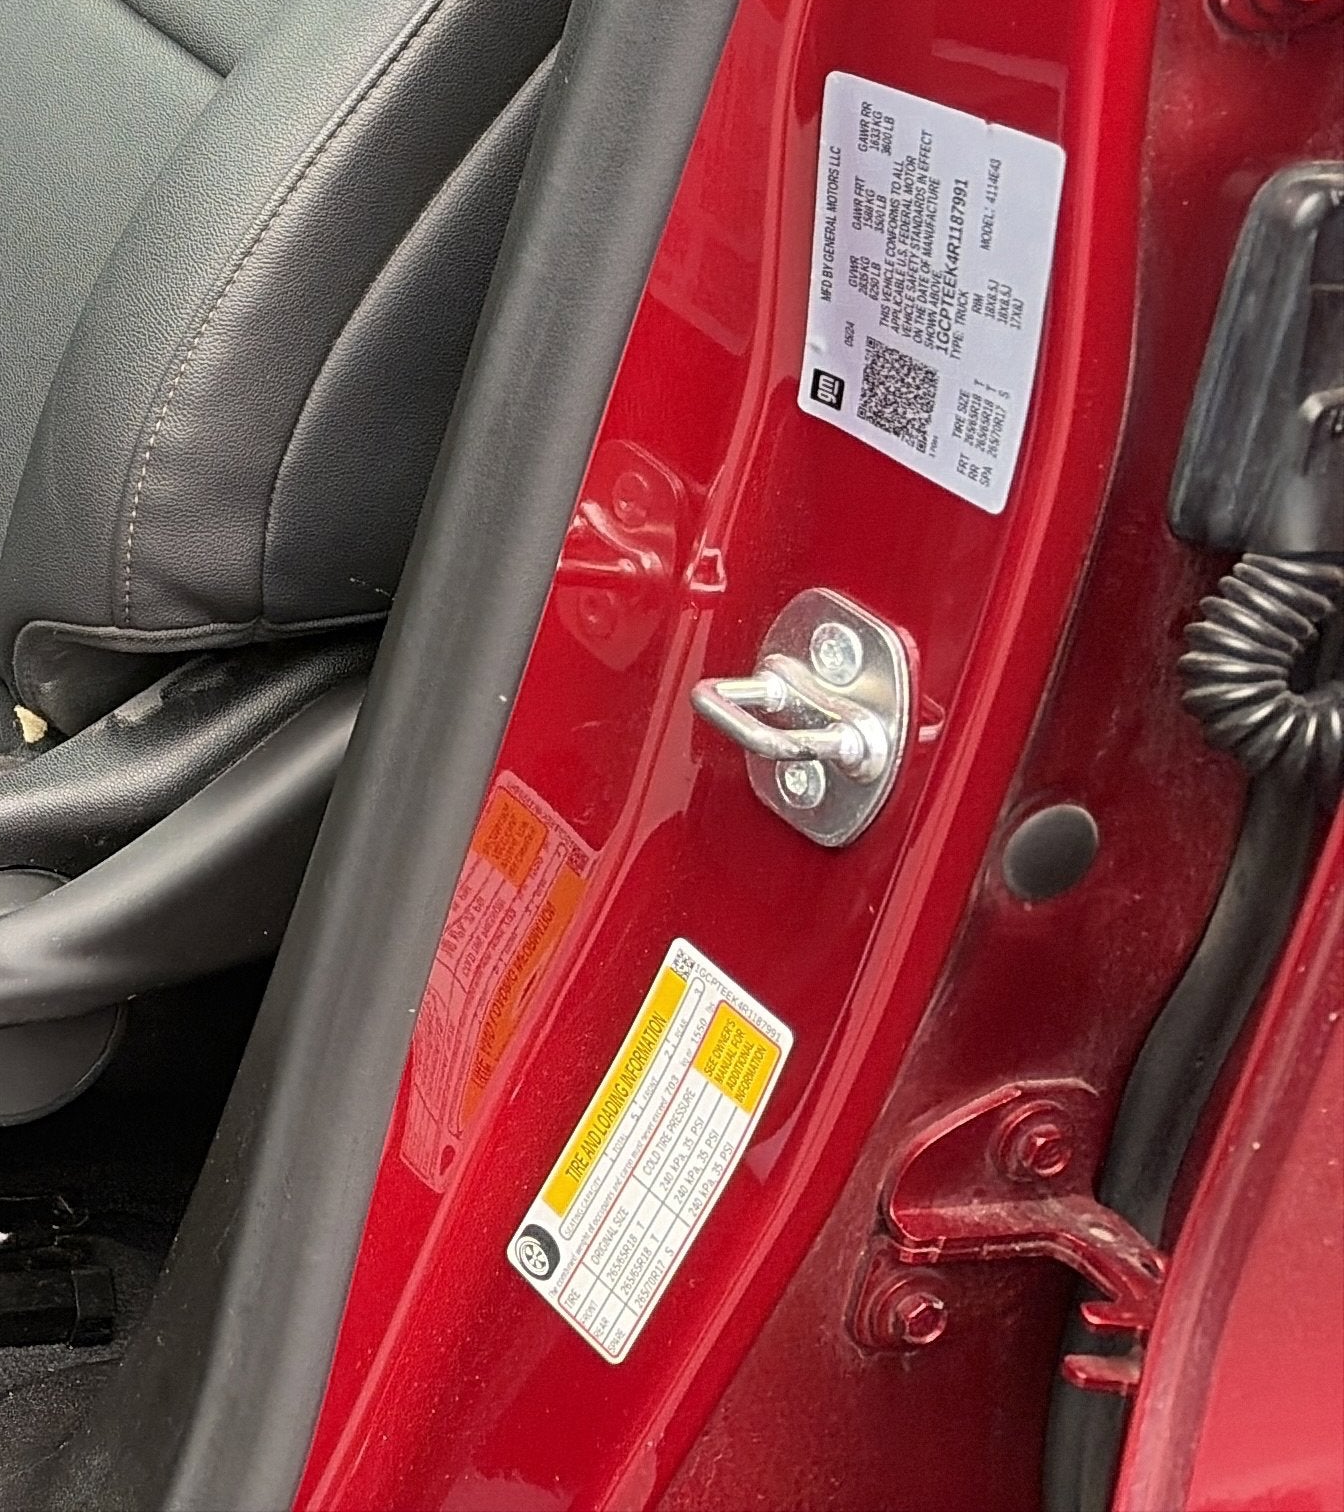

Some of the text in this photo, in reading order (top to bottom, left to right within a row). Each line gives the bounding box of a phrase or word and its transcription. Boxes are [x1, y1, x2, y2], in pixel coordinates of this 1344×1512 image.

[857, 101, 872, 152] GAWR RR
[869, 110, 883, 152] 1633 KG
[880, 115, 894, 156] 3600 LB
[902, 155, 917, 196] MOTOR
[820, 145, 842, 302] MFD BY GENERAL MOTORS LLC
[851, 175, 865, 231] GAWR FRT
[862, 188, 875, 229] 1588 KG
[873, 194, 887, 234] 3500 LB
[897, 198, 913, 246] FEDERAL
[878, 160, 904, 327] THIS VEHICLE CONFORMS TO ALL
[901, 129, 933, 338] VEHICLE SAFETY STANDARDS IN EFFECT
[848, 255, 860, 288] GVWR
[859, 255, 870, 273] KG
[868, 261, 881, 301] 6250 LB
[912, 179, 940, 344] ON THE DATE OF MANUFACTURE
[936, 179, 968, 354] 1GCPTEEK4R1187991
[890, 269, 906, 334] APPLICABLE
[954, 289, 969, 326] TRUCK
[971, 293, 984, 315] RIM
[923, 308, 938, 350] SHOWN
[951, 388, 970, 439] TIRE SIZE
[980, 465, 993, 488] SPA
[997, 389, 1010, 400] S
[956, 452, 969, 476] FRT
[967, 463, 980, 482] RR
[703, 1056, 718, 1077] SEE
[713, 1027, 746, 1085] MANUAL FOR
[725, 1041, 755, 1091] ADDITIONAL
[733, 1044, 767, 1103] INFORMATION
[564, 1010, 667, 1184] TIRE AND LOADING INFORMATION
[642, 1086, 696, 1176] COLD TIRE PRESSURE
[659, 1171, 674, 1192] 240
[682, 1136, 694, 1151] 35
[689, 1115, 705, 1136] PSI
[673, 1184, 689, 1205] 240
[696, 1148, 709, 1164] 35
[704, 1128, 719, 1149] PSI
[687, 1196, 703, 1218] 240
[711, 1161, 724, 1177] 35
[719, 1141, 735, 1162] PSI
[590, 1205, 629, 1266] ORIGINAL SIZE
[606, 1233, 638, 1283] 265/65R18
[620, 1246, 652, 1296] 265/65R18
[634, 1245, 675, 1310] 265/70R17 S
[563, 1287, 581, 1309] TIRE
